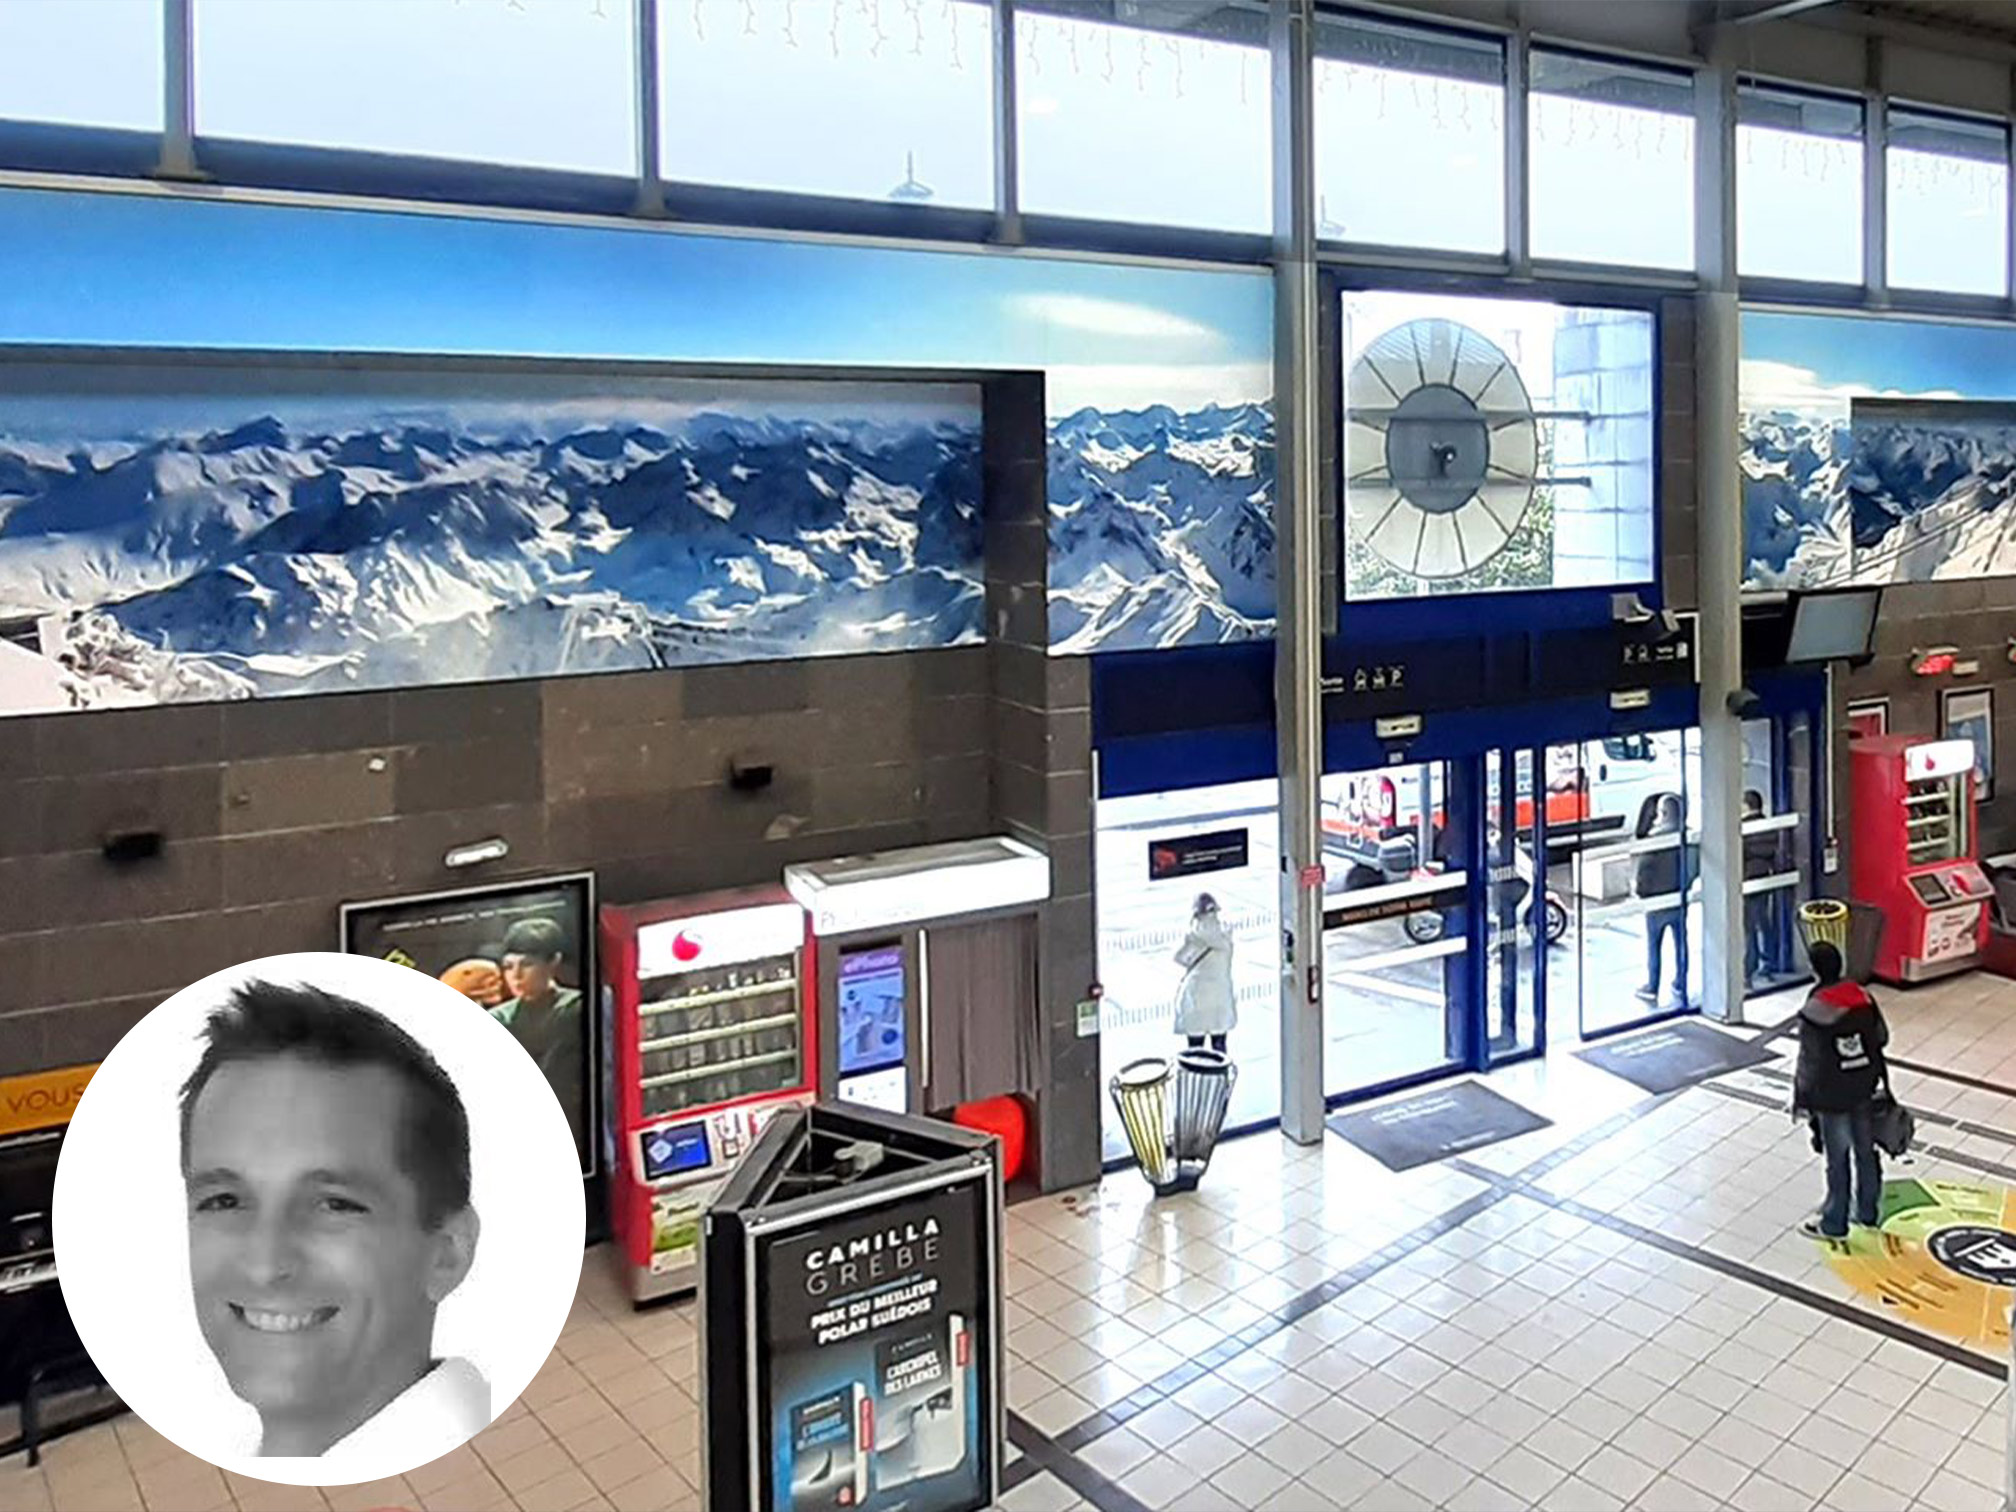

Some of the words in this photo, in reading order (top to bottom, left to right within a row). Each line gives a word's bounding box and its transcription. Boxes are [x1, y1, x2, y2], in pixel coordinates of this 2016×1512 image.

[806, 1218, 940, 1270] CAMILLA
[806, 1237, 940, 1295] GREBE
[811, 1307, 847, 1329] PRIX
[849, 1300, 871, 1318] DU
[873, 1279, 938, 1309] MEILLEUR
[818, 1318, 868, 1344] POLAR
